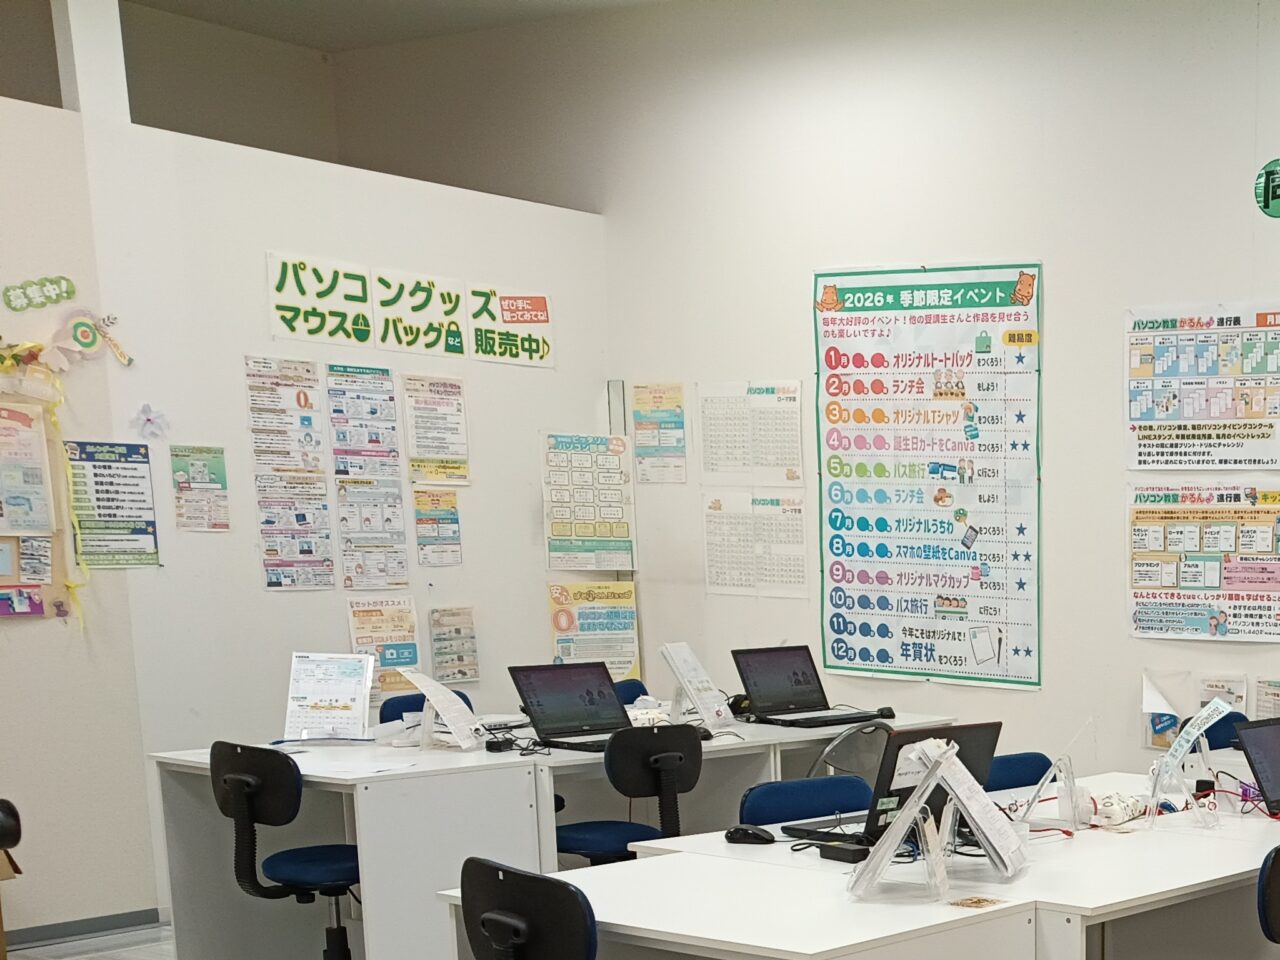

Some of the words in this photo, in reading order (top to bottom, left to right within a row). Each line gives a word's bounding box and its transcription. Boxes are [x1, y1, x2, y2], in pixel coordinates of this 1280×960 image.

[8, 283, 69, 310] 募集中!
[275, 260, 498, 322] パソコングッズ
[844, 291, 894, 307] 2026年
[899, 286, 1006, 307] 季節限定イベント
[275, 304, 352, 339] マウス
[380, 316, 445, 350] バッグ
[447, 337, 461, 347] など
[1133, 318, 1177, 331] パソコン教室
[1008, 332, 1033, 343] 難易度
[829, 350, 848, 364] 1月
[893, 350, 974, 368] オリジナルトートバッグ
[832, 378, 849, 392] 2月
[892, 378, 925, 394] ランチ会
[829, 405, 849, 420] 3月
[893, 409, 960, 425] オリジナルTシャツ
[829, 431, 850, 448] 4月
[894, 435, 975, 452] 誕生日カードをCanva
[830, 458, 850, 475] 5月
[893, 461, 926, 477] バス旅行
[831, 485, 852, 499] 6月
[895, 488, 925, 504] ランチ会
[1134, 493, 1179, 504] パソコン教室
[831, 512, 852, 527] 7月
[895, 517, 954, 533] オリジナルうちわ
[832, 538, 852, 554] 8月
[895, 544, 977, 561] スマホの壁紙をCanva
[832, 564, 852, 580] 9月
[896, 570, 970, 589] オリジナルマグカップ
[830, 592, 852, 607] 10月
[896, 597, 928, 615] バス旅行
[831, 617, 854, 634] 11月
[832, 643, 855, 660] 12月
[900, 641, 936, 663] 年賀状
